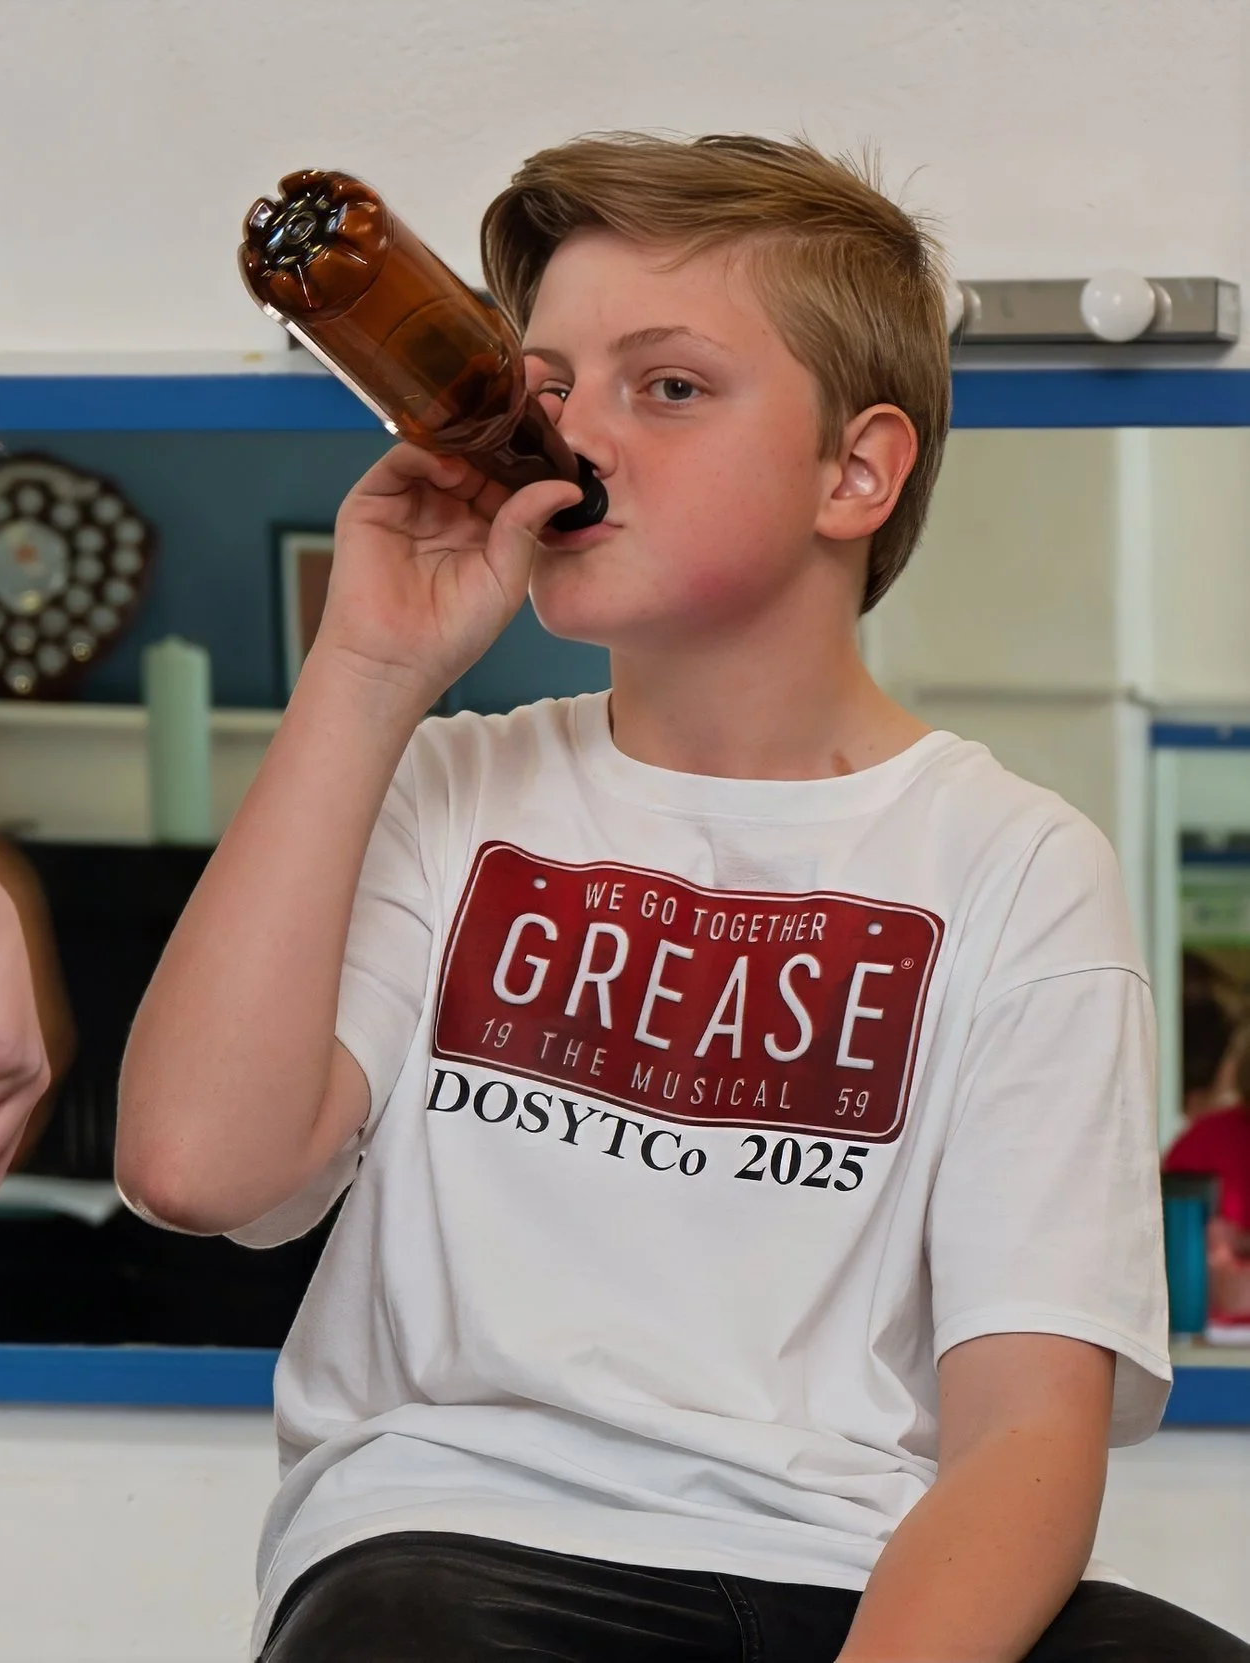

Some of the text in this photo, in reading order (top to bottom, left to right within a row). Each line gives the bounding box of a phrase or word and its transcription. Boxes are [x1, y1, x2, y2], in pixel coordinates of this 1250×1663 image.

[584, 882, 827, 943] WE GO TOGETHER
[492, 912, 895, 1070] GREASE
[480, 1017, 870, 1118] 19 THE MUSICAL 59
[426, 1069, 870, 1192] DOSYTCo 2025
